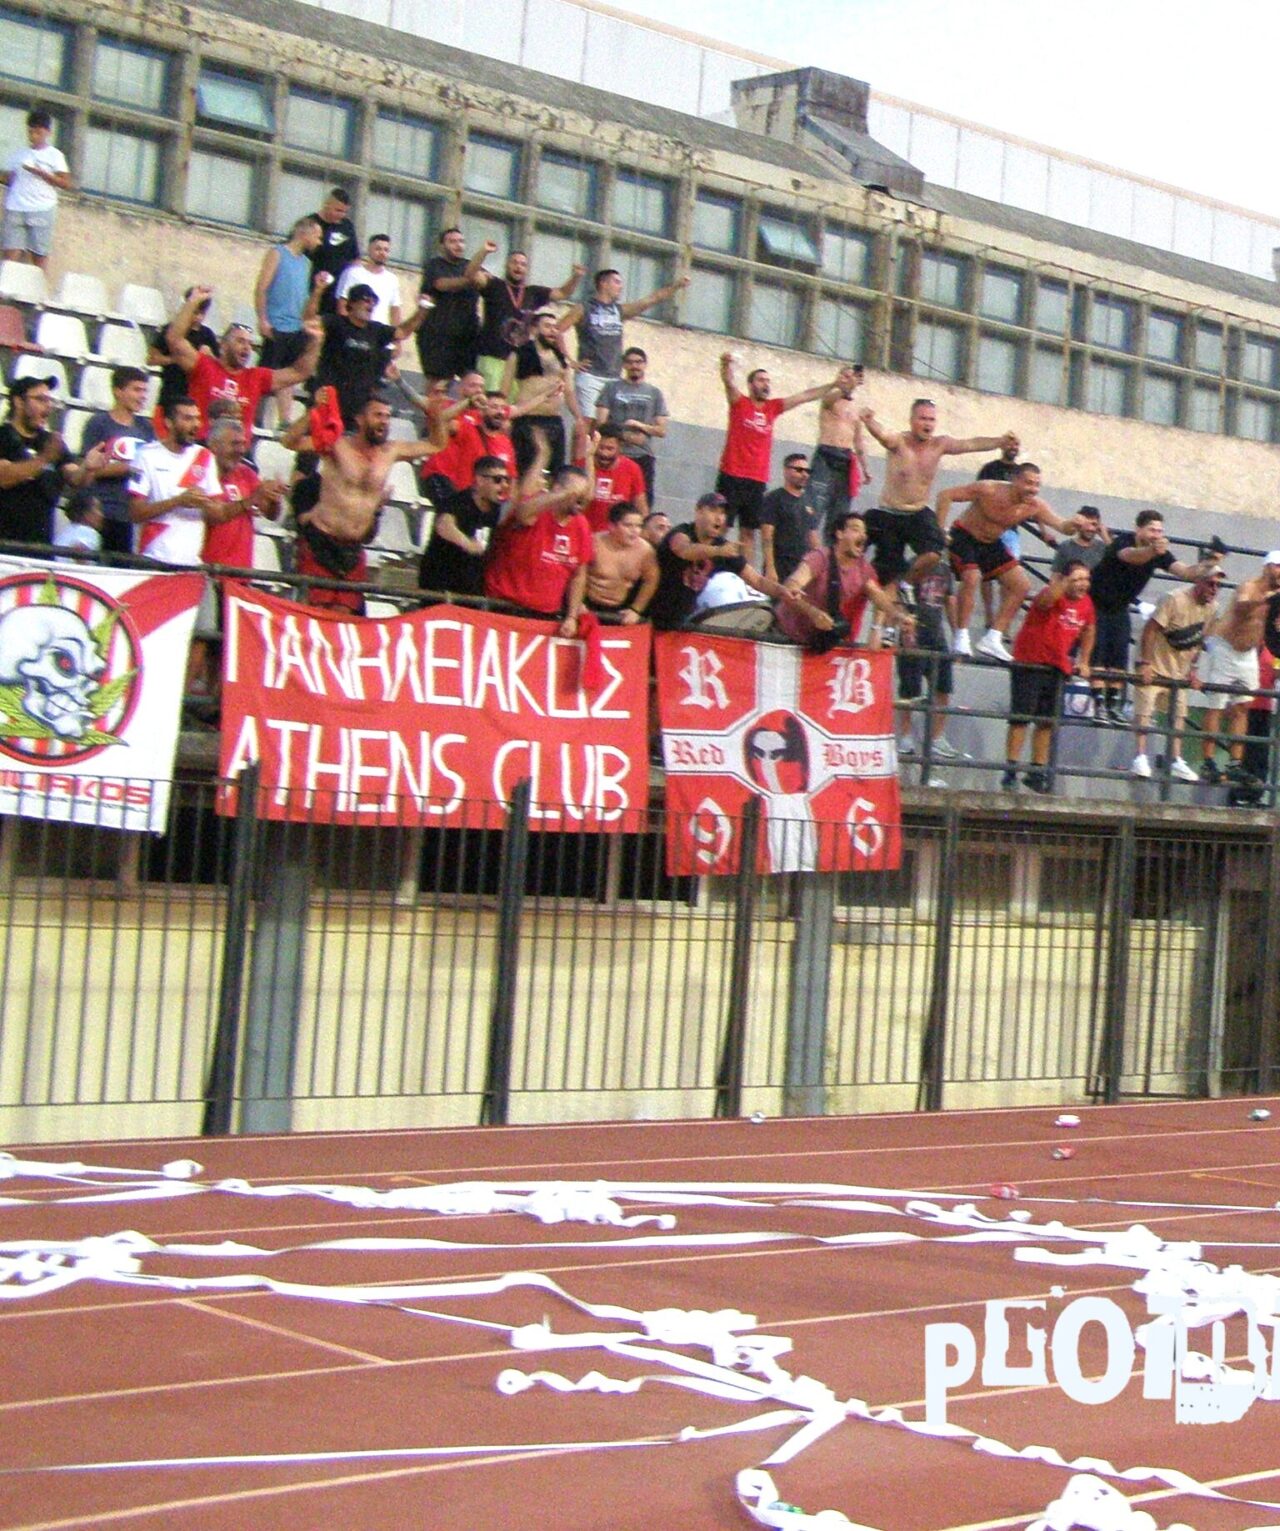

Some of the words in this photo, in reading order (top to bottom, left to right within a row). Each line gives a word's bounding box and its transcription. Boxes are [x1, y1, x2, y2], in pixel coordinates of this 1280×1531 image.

[222, 715, 468, 815] ATHENS
[493, 739, 631, 822] CLUB
[671, 739, 725, 766] Red
[822, 737, 885, 769] Boys
